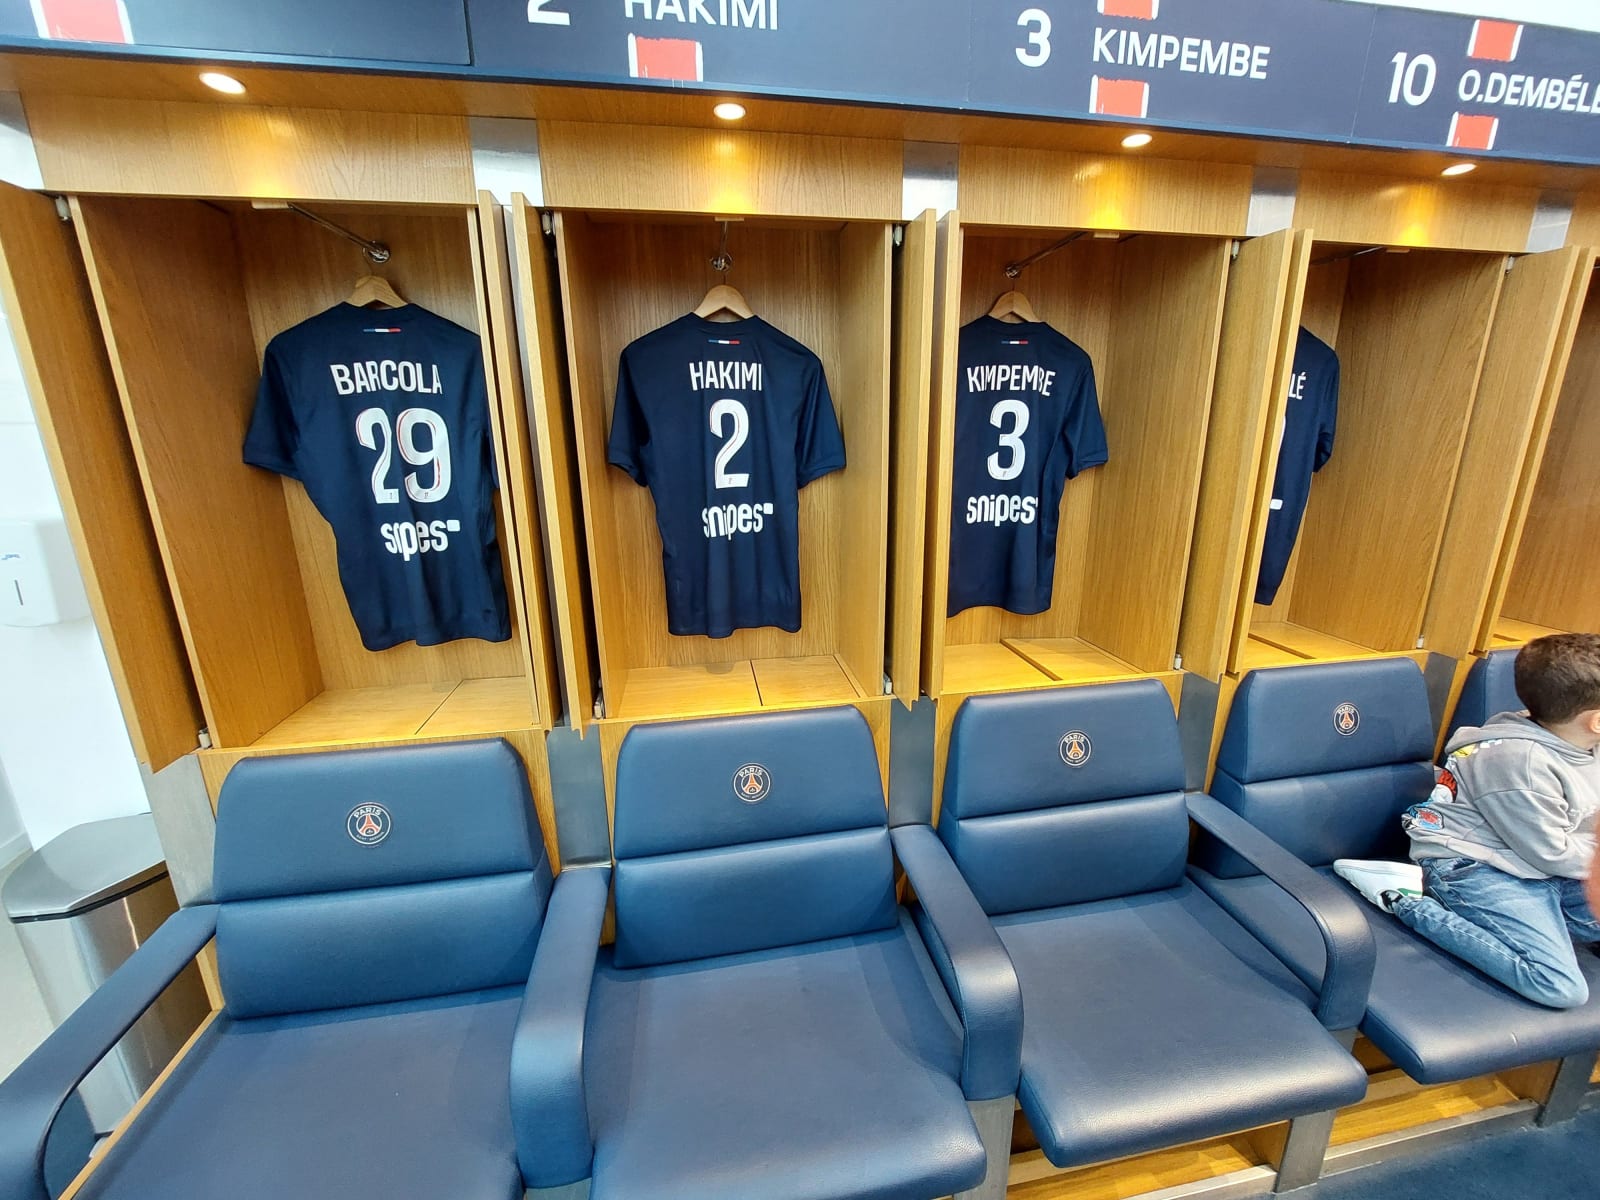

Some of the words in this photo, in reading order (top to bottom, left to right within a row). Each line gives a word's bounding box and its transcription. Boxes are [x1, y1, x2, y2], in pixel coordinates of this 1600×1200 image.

[1015, 8, 1052, 68] 3
[1092, 27, 1271, 80] KIMPEMBE
[1388, 51, 1437, 106] 10
[330, 359, 443, 395] BARCOLA
[689, 360, 762, 391] HAKIMI
[355, 407, 452, 504] 29
[709, 398, 750, 489] 2
[987, 399, 1030, 481] 3
[701, 502, 764, 541] snipes
[966, 494, 1035, 527] snipes
[353, 807, 381, 818] PARIS
